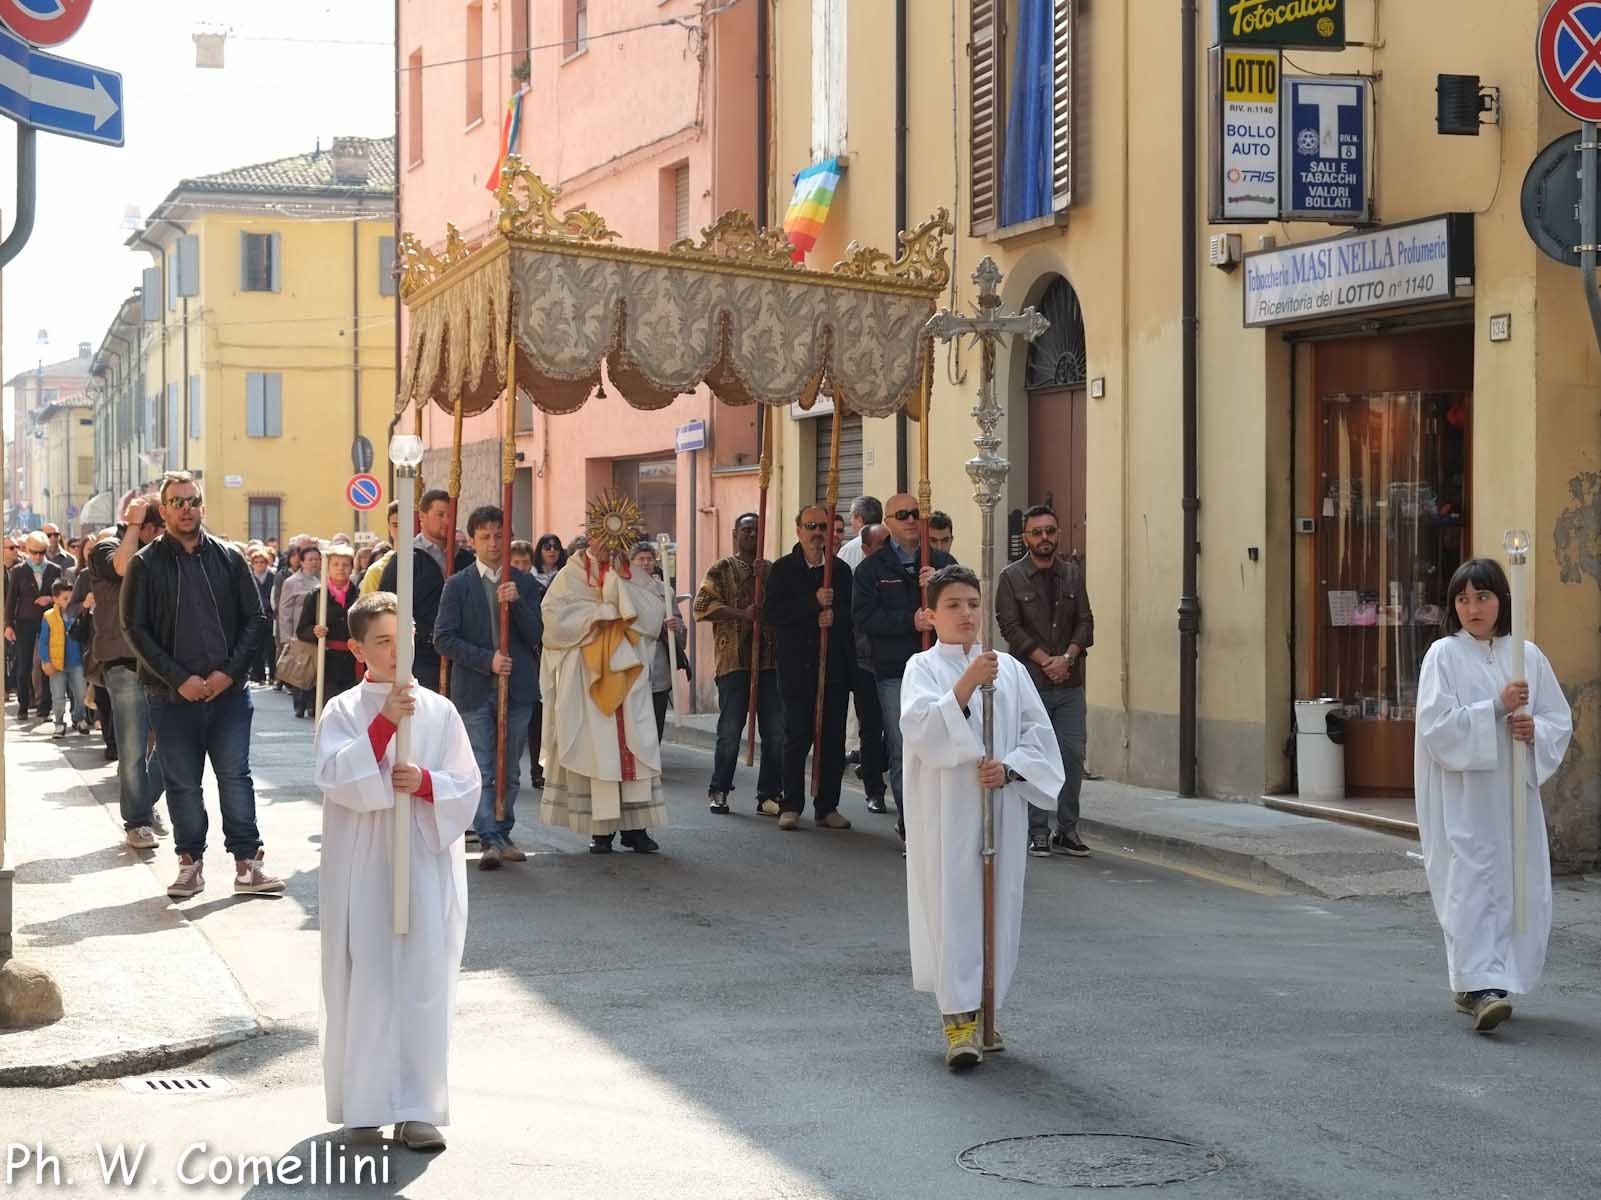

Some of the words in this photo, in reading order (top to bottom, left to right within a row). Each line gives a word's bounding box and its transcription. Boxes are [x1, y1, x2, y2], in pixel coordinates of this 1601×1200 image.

[1226, 58, 1276, 94] LOTTO
[1229, 105, 1244, 113] RIV.
[1298, 84, 1357, 159] T
[1227, 124, 1276, 138] BOLLO
[1232, 143, 1270, 156] AUTO
[1310, 161, 1336, 173] SALI
[1341, 162, 1348, 173] E
[1300, 172, 1357, 185] TABACCHI
[1309, 186, 1349, 198] VALORI
[1305, 197, 1351, 209] BOLLATI
[1291, 247, 1333, 286] MASI
[1337, 236, 1395, 277] NELLA
[1399, 234, 1447, 267] Profumeria
[1259, 292, 1313, 317] Ricevitoria
[1316, 291, 1333, 308] del
[1337, 280, 1385, 305] LOTTO
[1405, 273, 1434, 294] 1140
